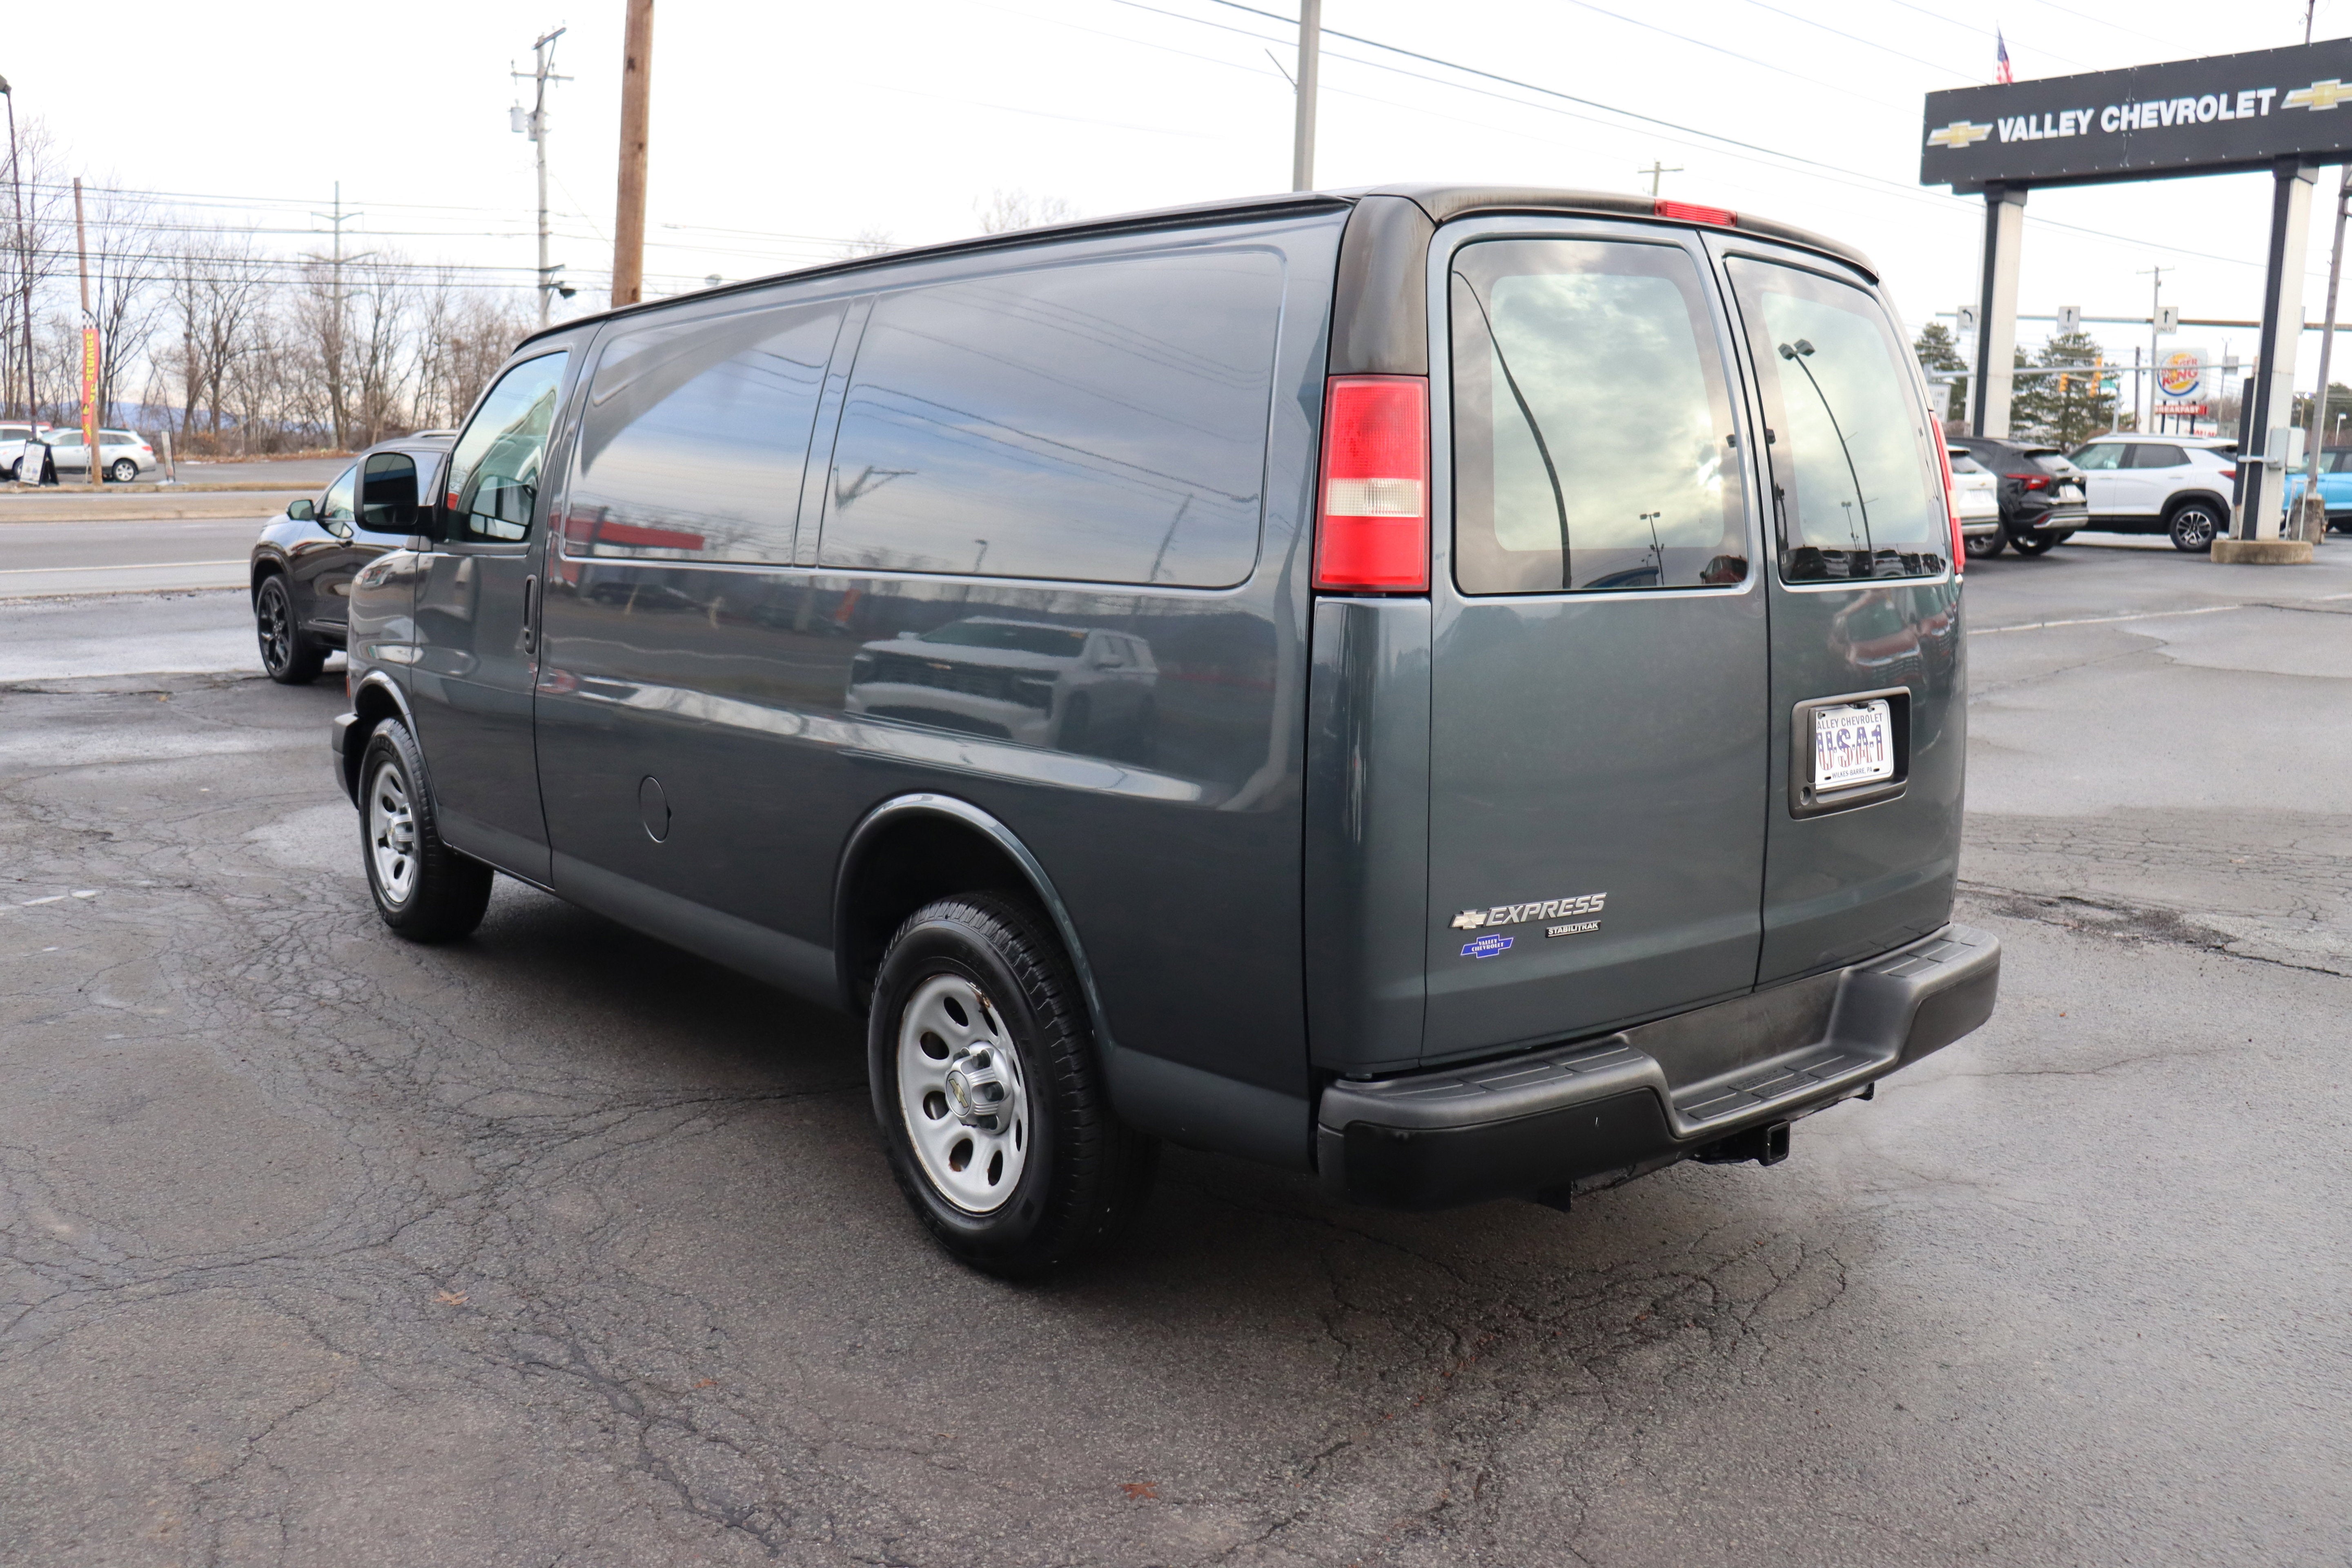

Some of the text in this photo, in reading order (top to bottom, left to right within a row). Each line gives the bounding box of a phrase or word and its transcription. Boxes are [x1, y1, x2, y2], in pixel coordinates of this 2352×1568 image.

[1997, 88, 2276, 143] VALLEY CHEVROLET
[1817, 713, 1882, 730] ALLEY CHEVROLET
[1832, 768, 1866, 779] WILKES-BARRE,
[1485, 894, 1607, 927] EXPRESS
[1548, 922, 1598, 935] STABILITRAK
[1471, 942, 1503, 952] CHEVROLET
